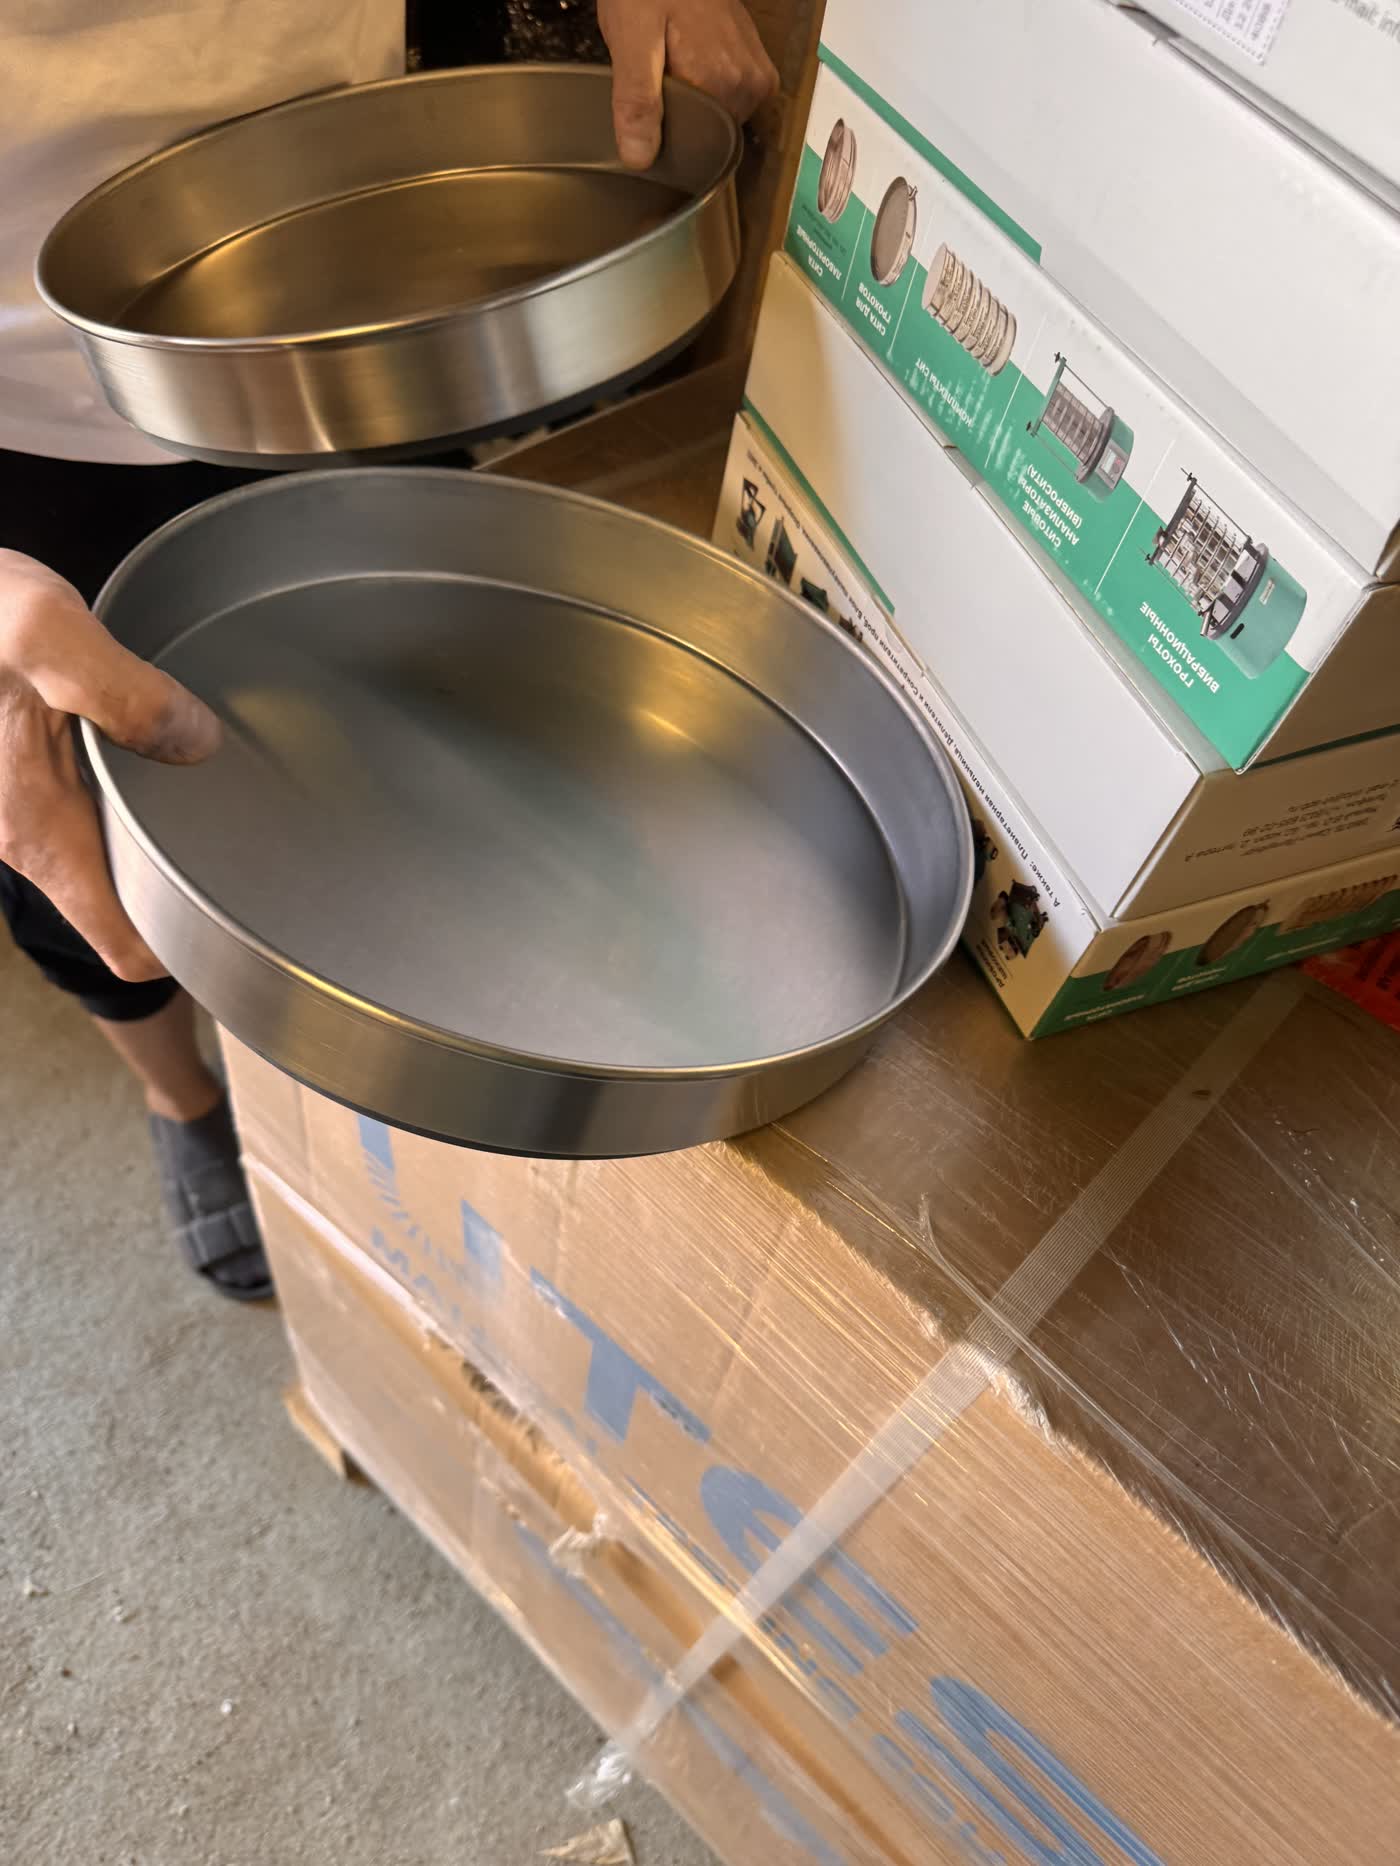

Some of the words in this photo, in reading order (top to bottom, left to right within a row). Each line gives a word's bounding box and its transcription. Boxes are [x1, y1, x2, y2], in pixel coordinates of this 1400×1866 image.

[855, 296, 870, 316] ДЛЯ
[858, 281, 890, 323] ГРОХОТОВ
[869, 311, 886, 335] СИТА
[915, 357, 930, 375] СИТ
[1018, 474, 1079, 545] АНАЛИЗАТОРЫ
[1027, 464, 1082, 528] (ВИБРОСИТА)
[1021, 500, 1061, 548] СИТОВЫЕ
[879, 639, 919, 694] Сократители
[1139, 600, 1219, 693] ВИБРАЦИОННЫЕ
[1147, 633, 1193, 688] ГРОХОТЫ
[923, 701, 953, 744] Делители
[984, 793, 1029, 859] Планетарная
[1029, 861, 1054, 897] также:
[1053, 897, 1061, 907] А
